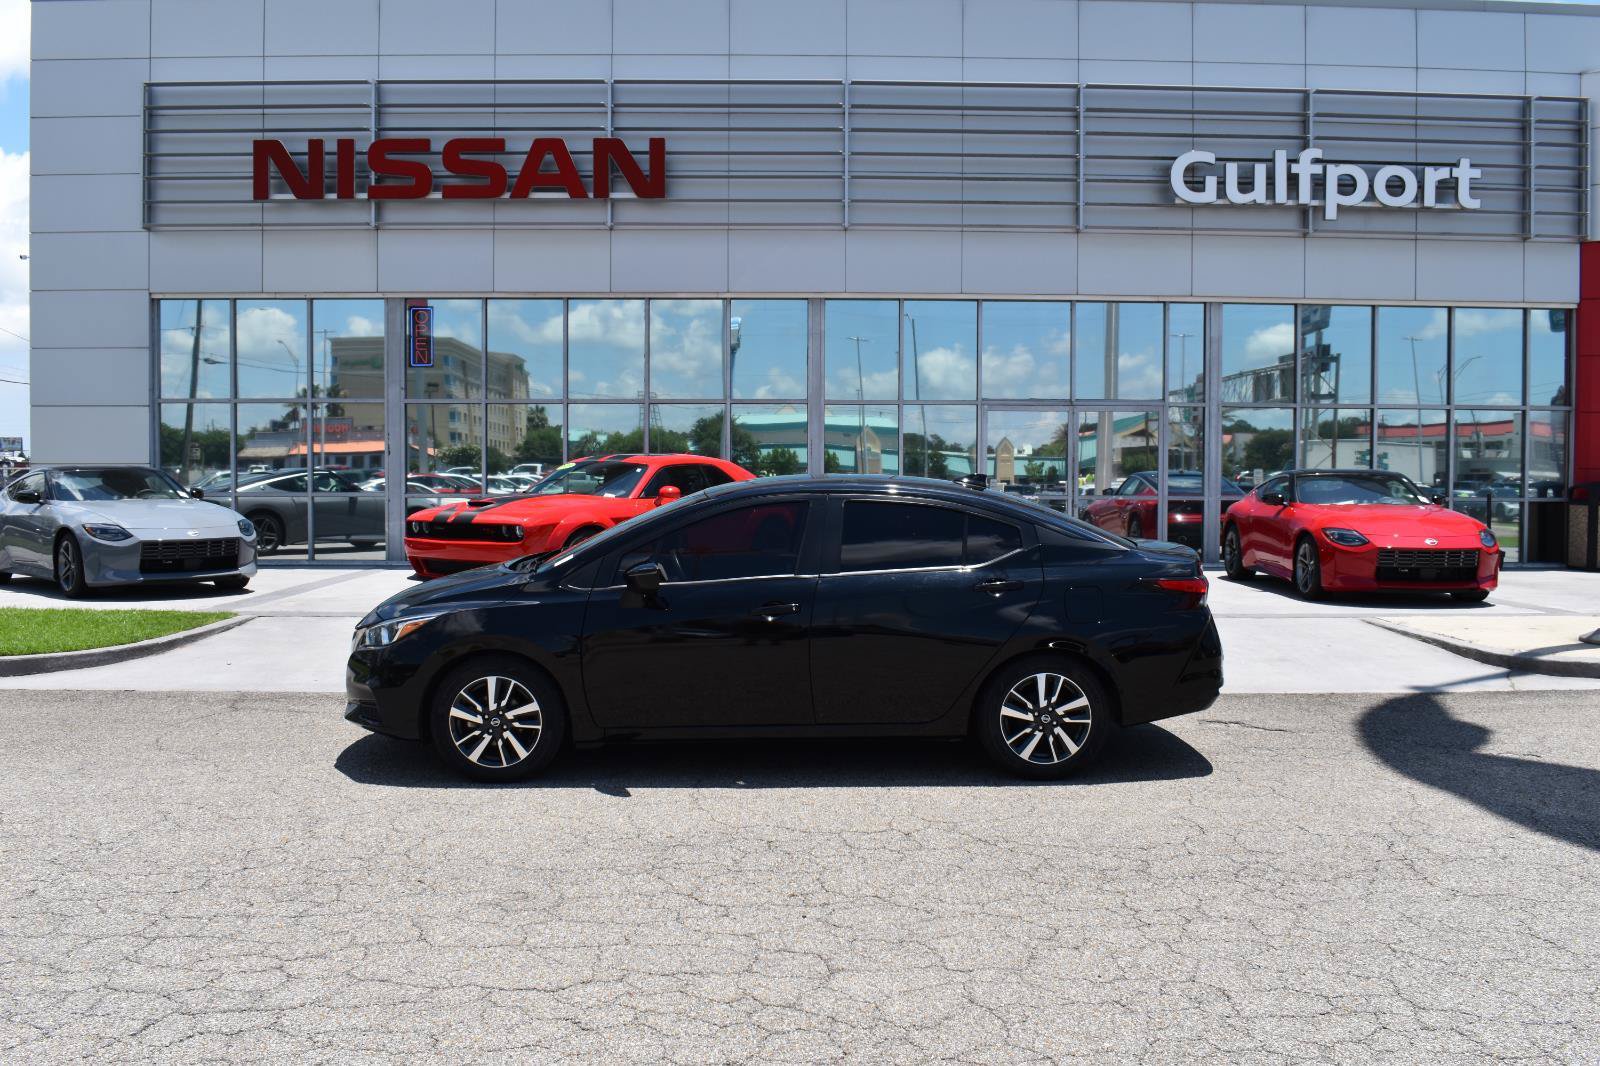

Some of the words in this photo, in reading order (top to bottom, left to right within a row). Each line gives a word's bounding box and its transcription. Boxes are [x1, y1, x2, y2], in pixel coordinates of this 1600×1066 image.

[252, 137, 666, 200] NISSAN
[1170, 148, 1482, 220] Gulfport
[414, 310, 429, 364] OPEN
